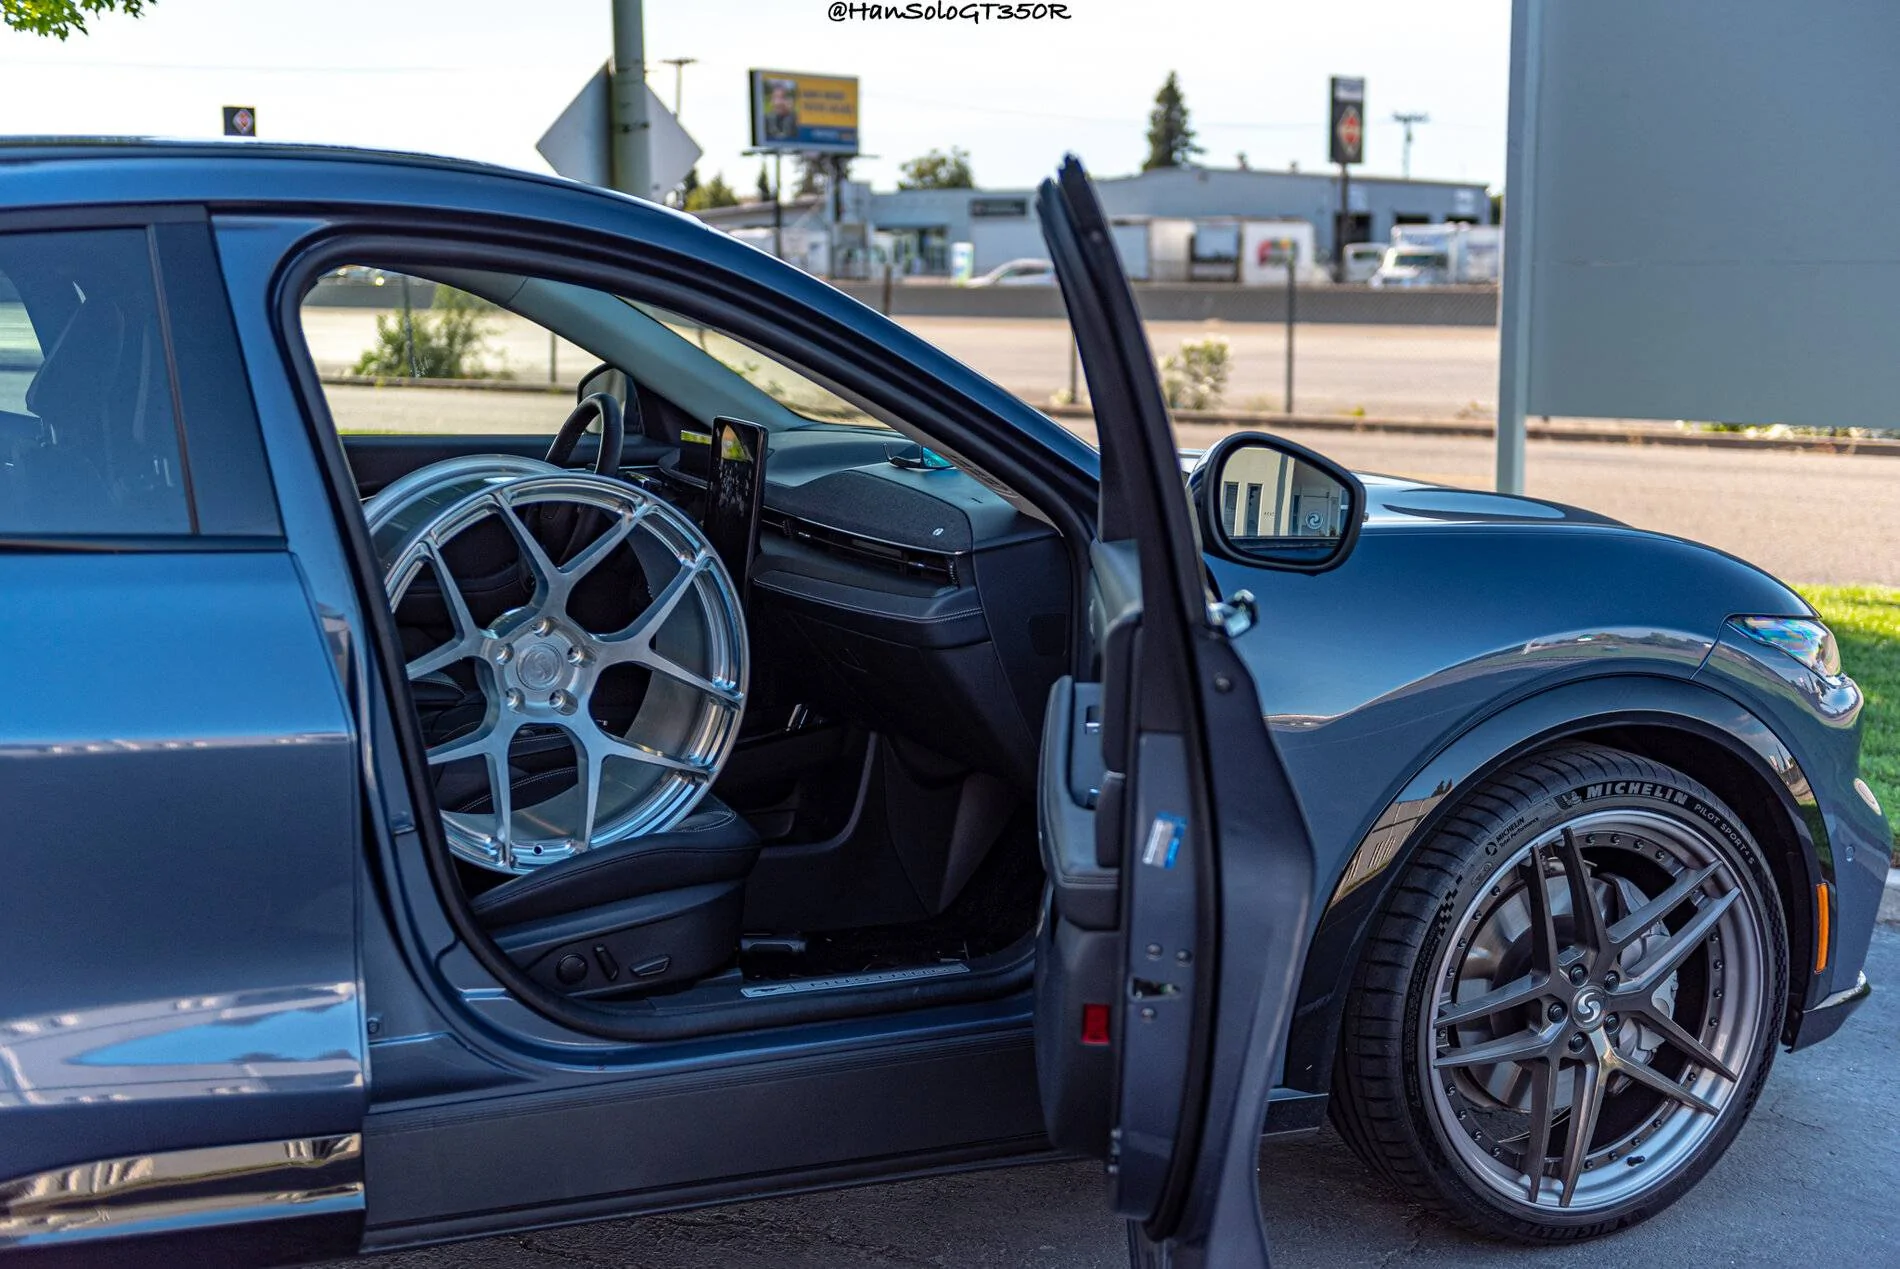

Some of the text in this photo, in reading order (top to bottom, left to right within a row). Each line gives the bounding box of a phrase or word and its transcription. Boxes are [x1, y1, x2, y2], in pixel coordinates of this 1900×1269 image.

[1496, 816, 1525, 843] MICHELIN
[1586, 781, 1690, 805] MICHELIN
[1694, 803, 1720, 824] PILOT
[1720, 823, 1747, 851] SPORT
